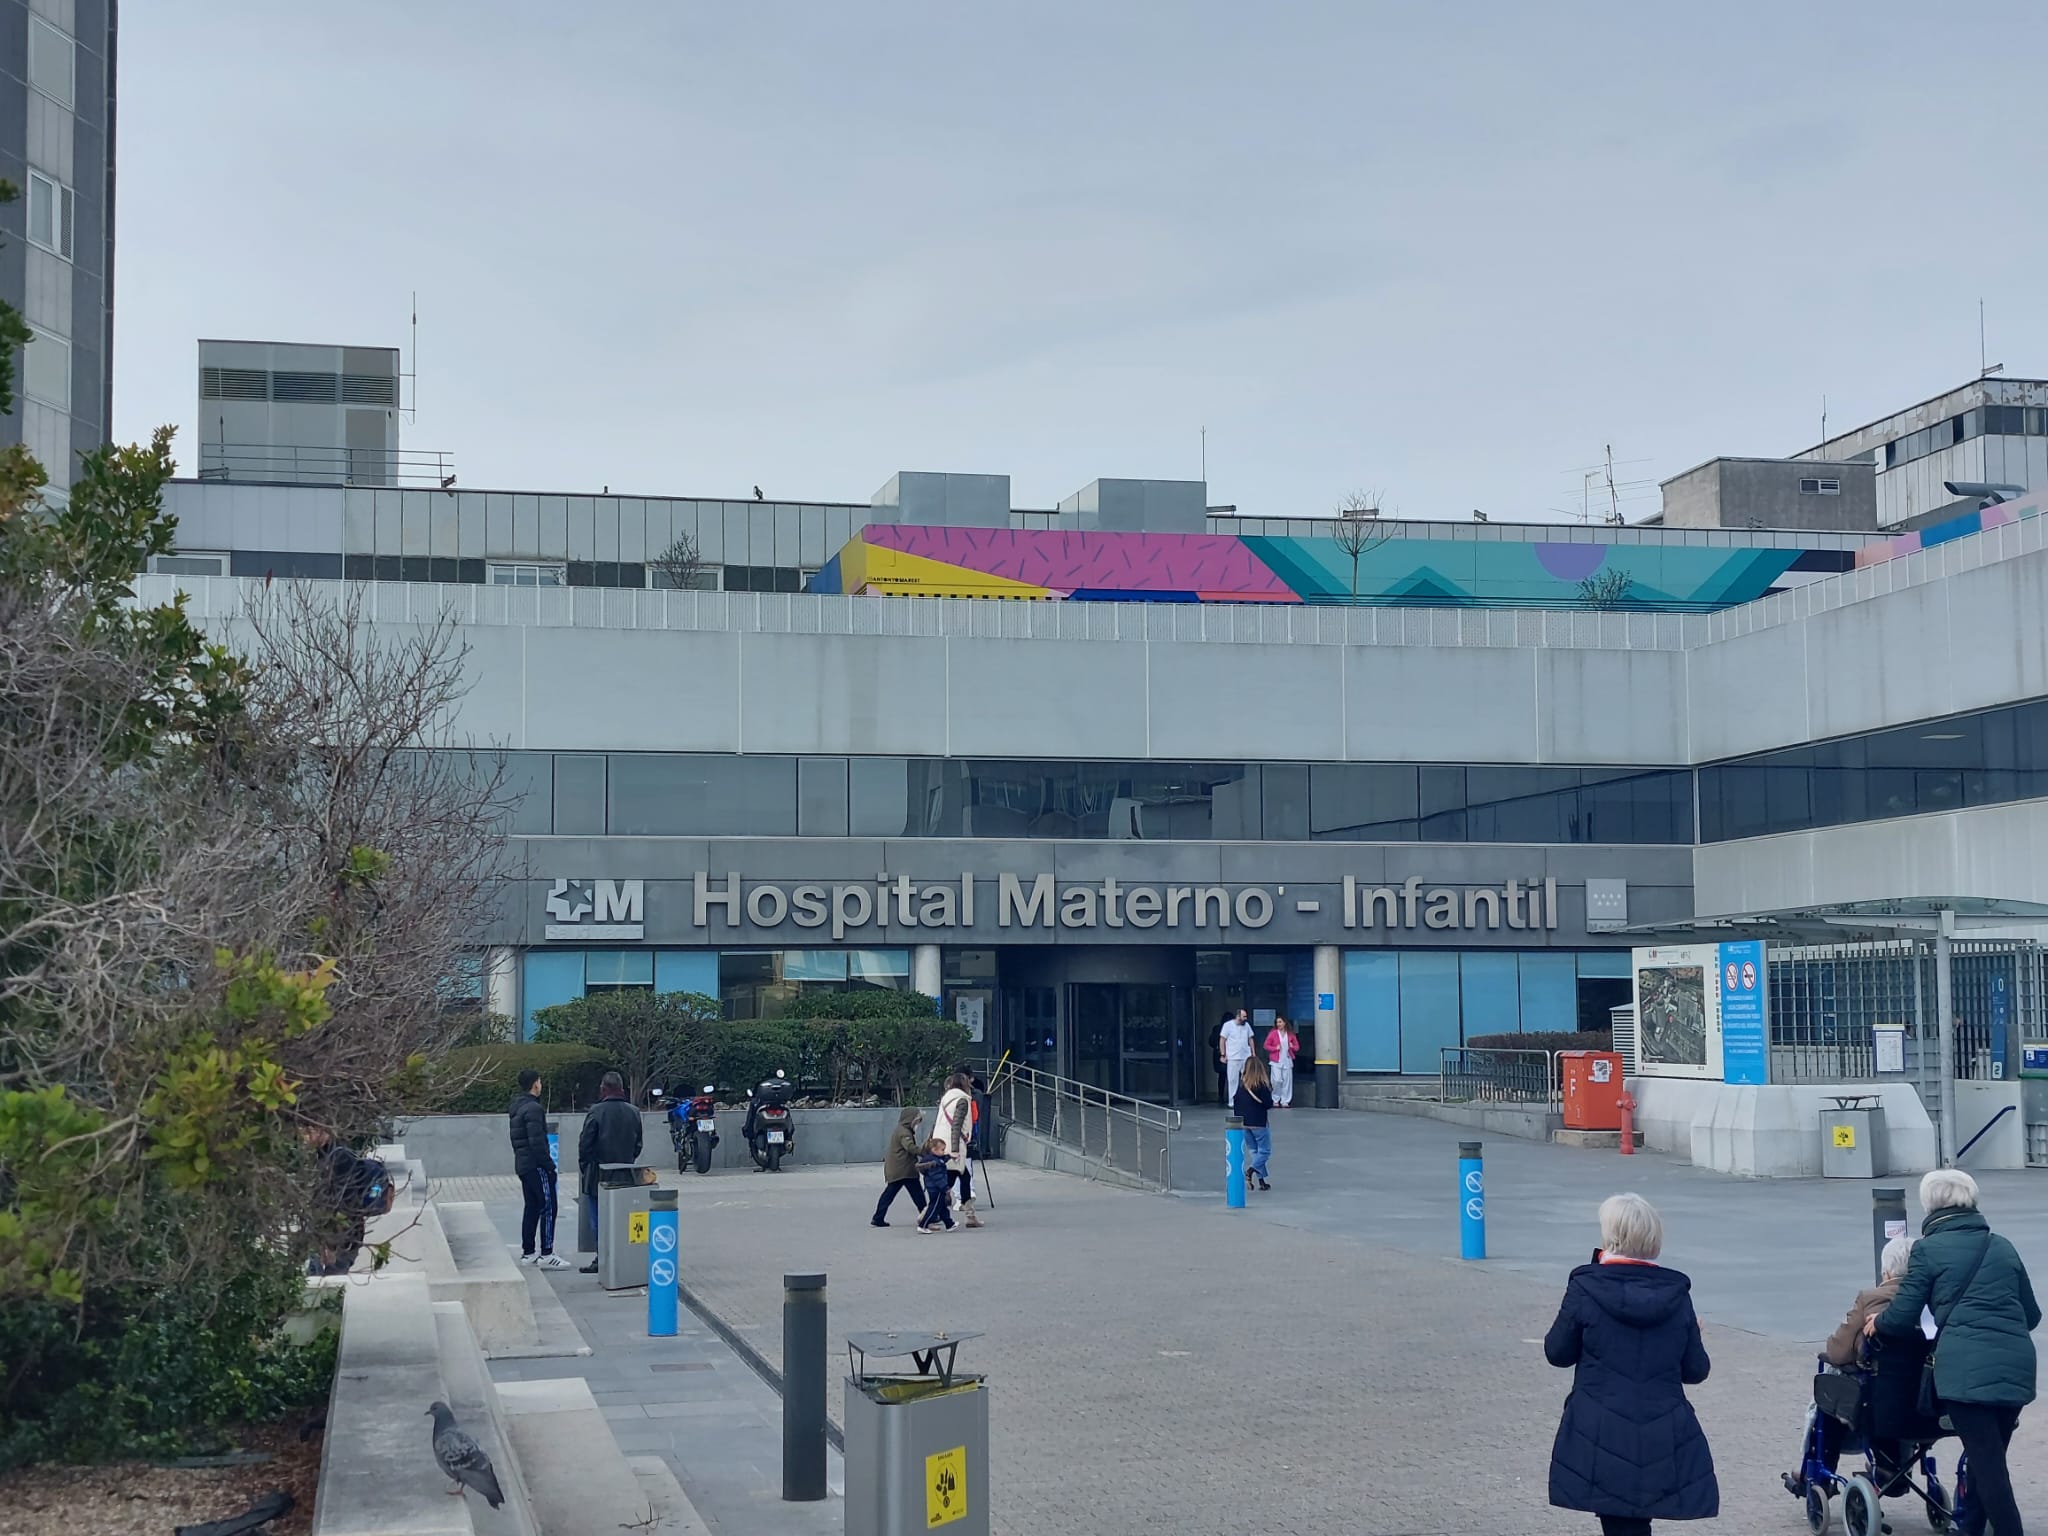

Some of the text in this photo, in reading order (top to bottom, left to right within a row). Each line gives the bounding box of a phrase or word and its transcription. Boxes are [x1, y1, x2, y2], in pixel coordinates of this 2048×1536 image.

[693, 871, 974, 939] Hospital
[999, 873, 1273, 928] Materno
[1343, 875, 1557, 929] Infantil
